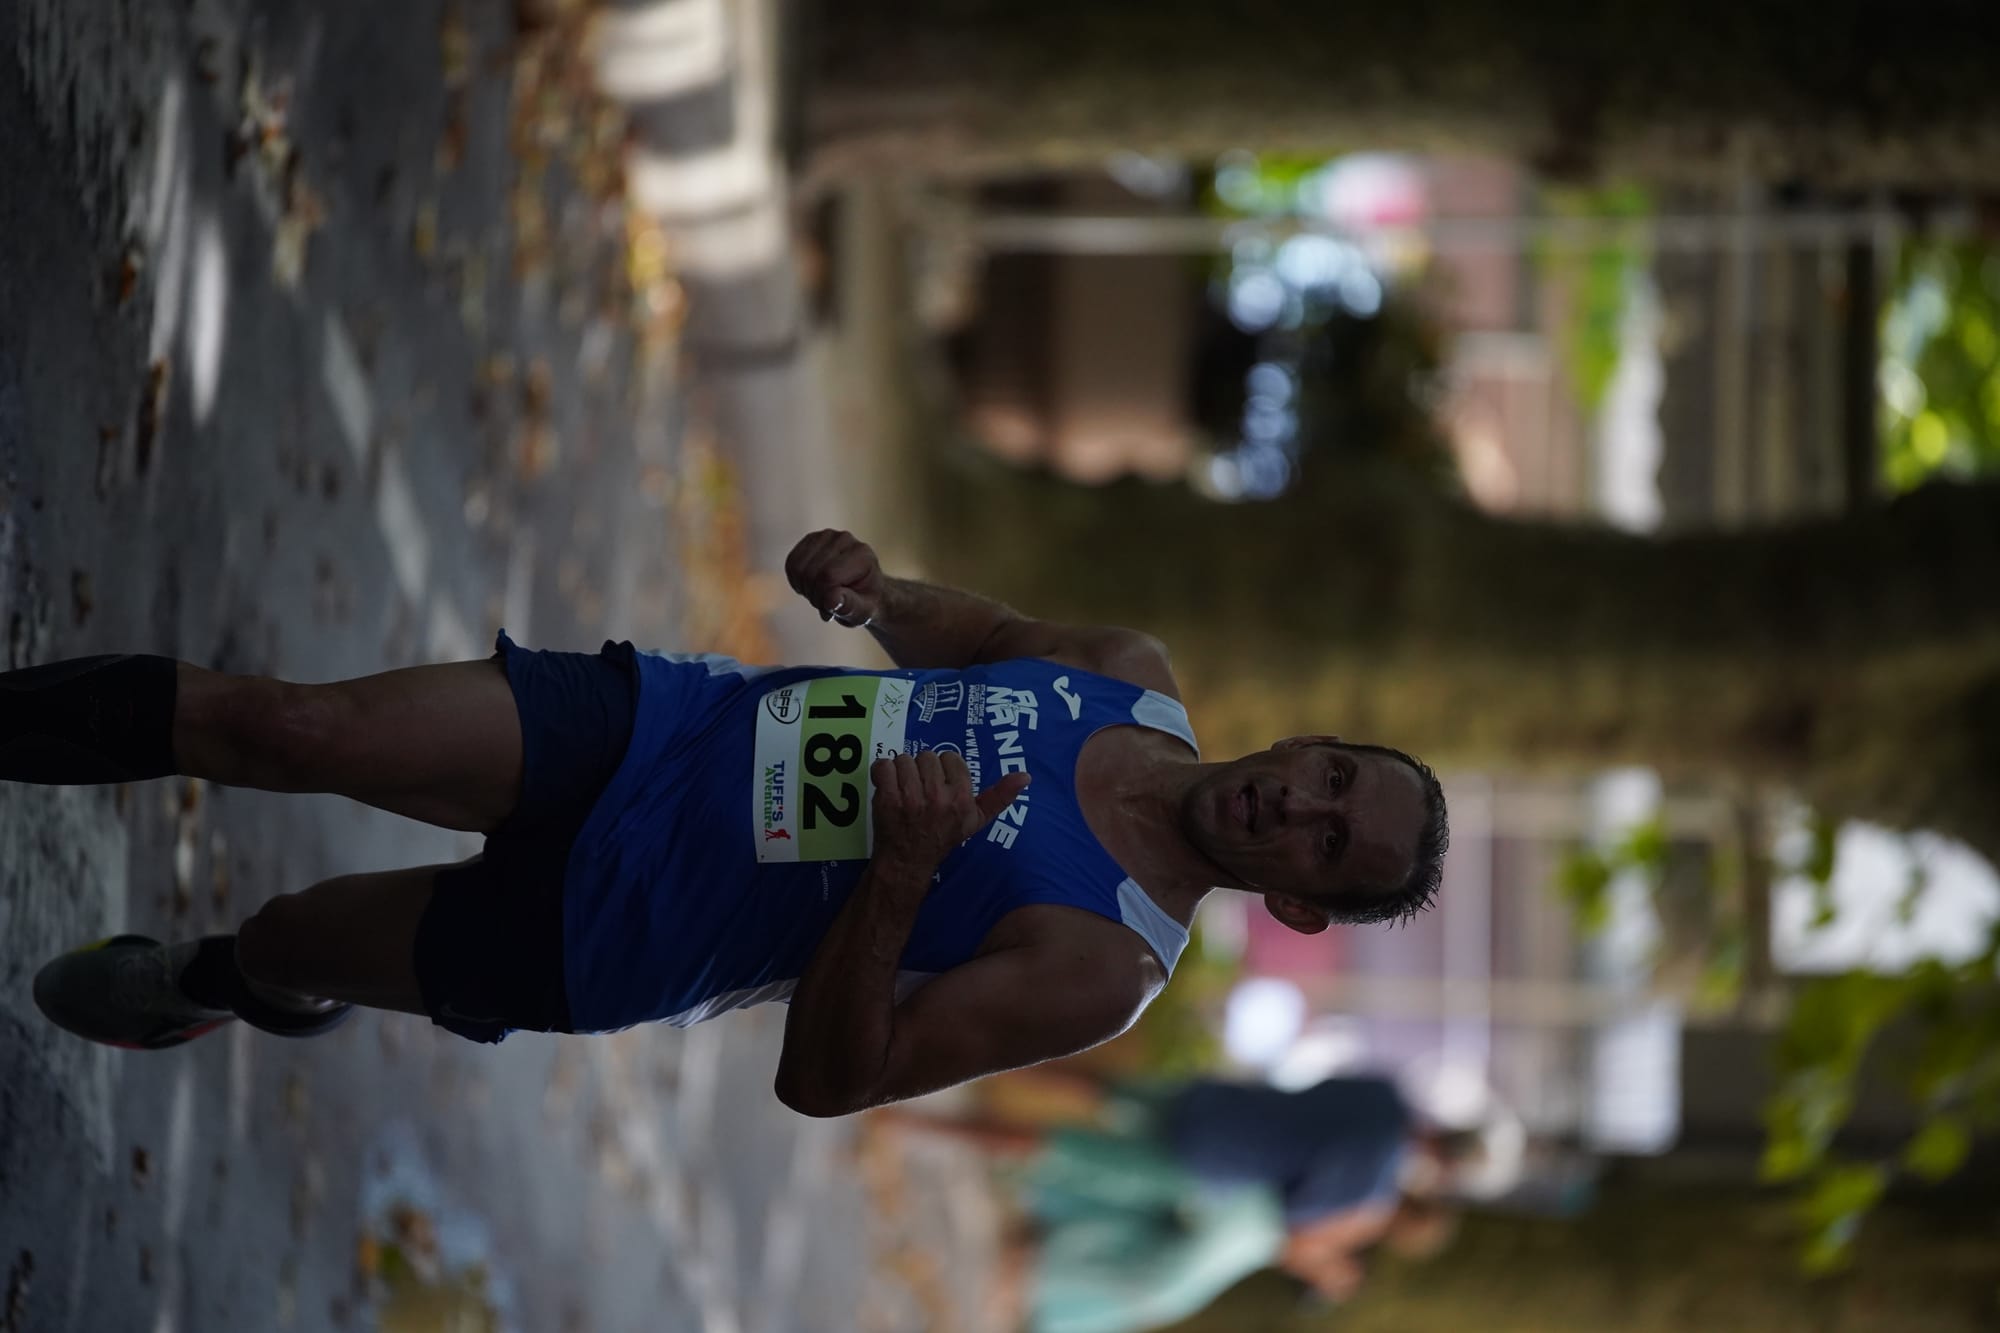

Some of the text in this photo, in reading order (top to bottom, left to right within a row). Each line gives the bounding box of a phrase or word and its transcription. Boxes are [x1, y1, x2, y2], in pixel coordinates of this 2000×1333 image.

[772, 760, 785, 822] TUFF'S
[803, 694, 867, 830] 182
[764, 767, 776, 829] Aventure
